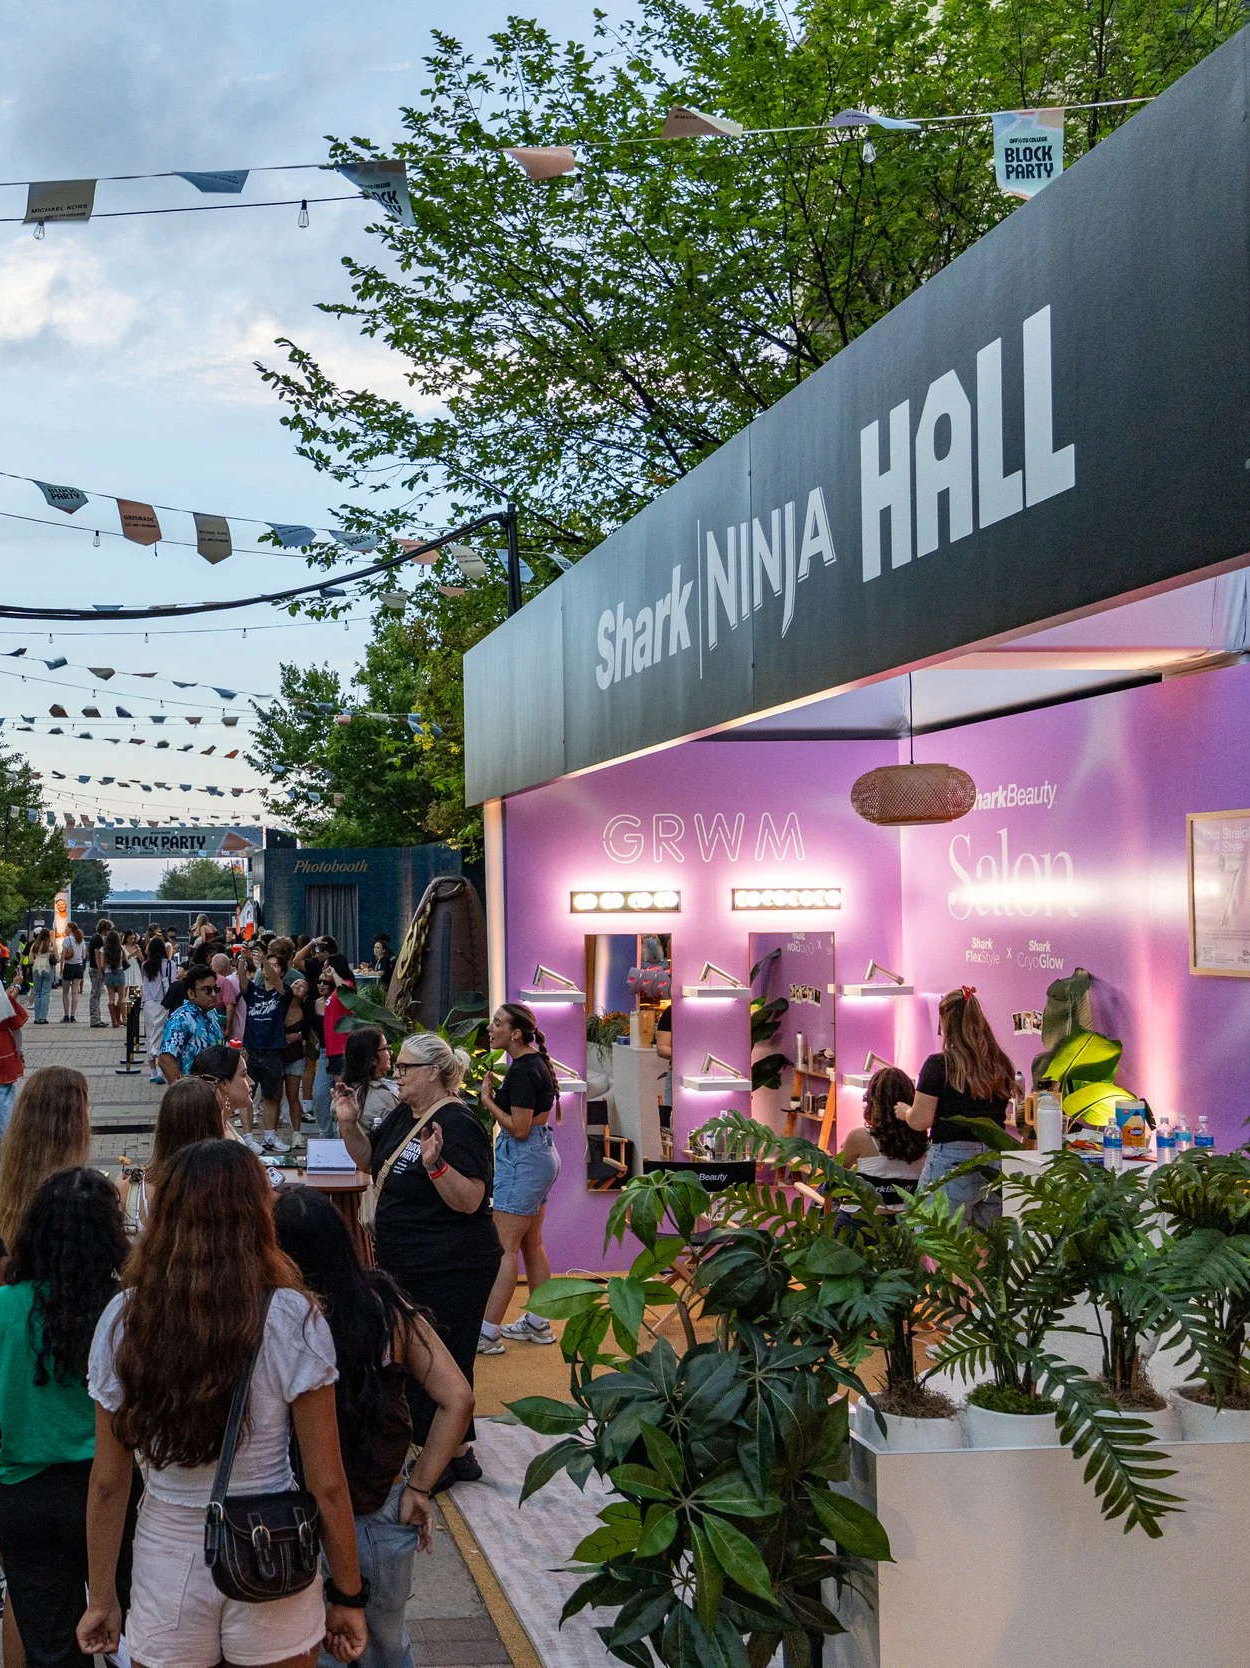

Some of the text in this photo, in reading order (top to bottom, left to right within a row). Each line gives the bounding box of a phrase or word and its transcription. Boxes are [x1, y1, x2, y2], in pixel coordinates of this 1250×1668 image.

[1005, 145, 1052, 163] BLOCK
[1005, 163, 1053, 179] PARTY
[595, 304, 1075, 690] Shark NINJA HALL
[973, 780, 1058, 811] harkBeauty
[115, 836, 206, 849] BLOCK PARTY
[603, 812, 806, 864] GRWM
[1222, 828, 1250, 841] Straig
[293, 859, 368, 873] Photobooth
[947, 828, 1081, 921] Salon
[971, 937, 993, 950] Shark
[1029, 939, 1052, 953] Shark
[965, 950, 1000, 966] FlexStyle
[1017, 952, 1064, 971] CryoGlow
[698, 1173, 727, 1182] Beauty
